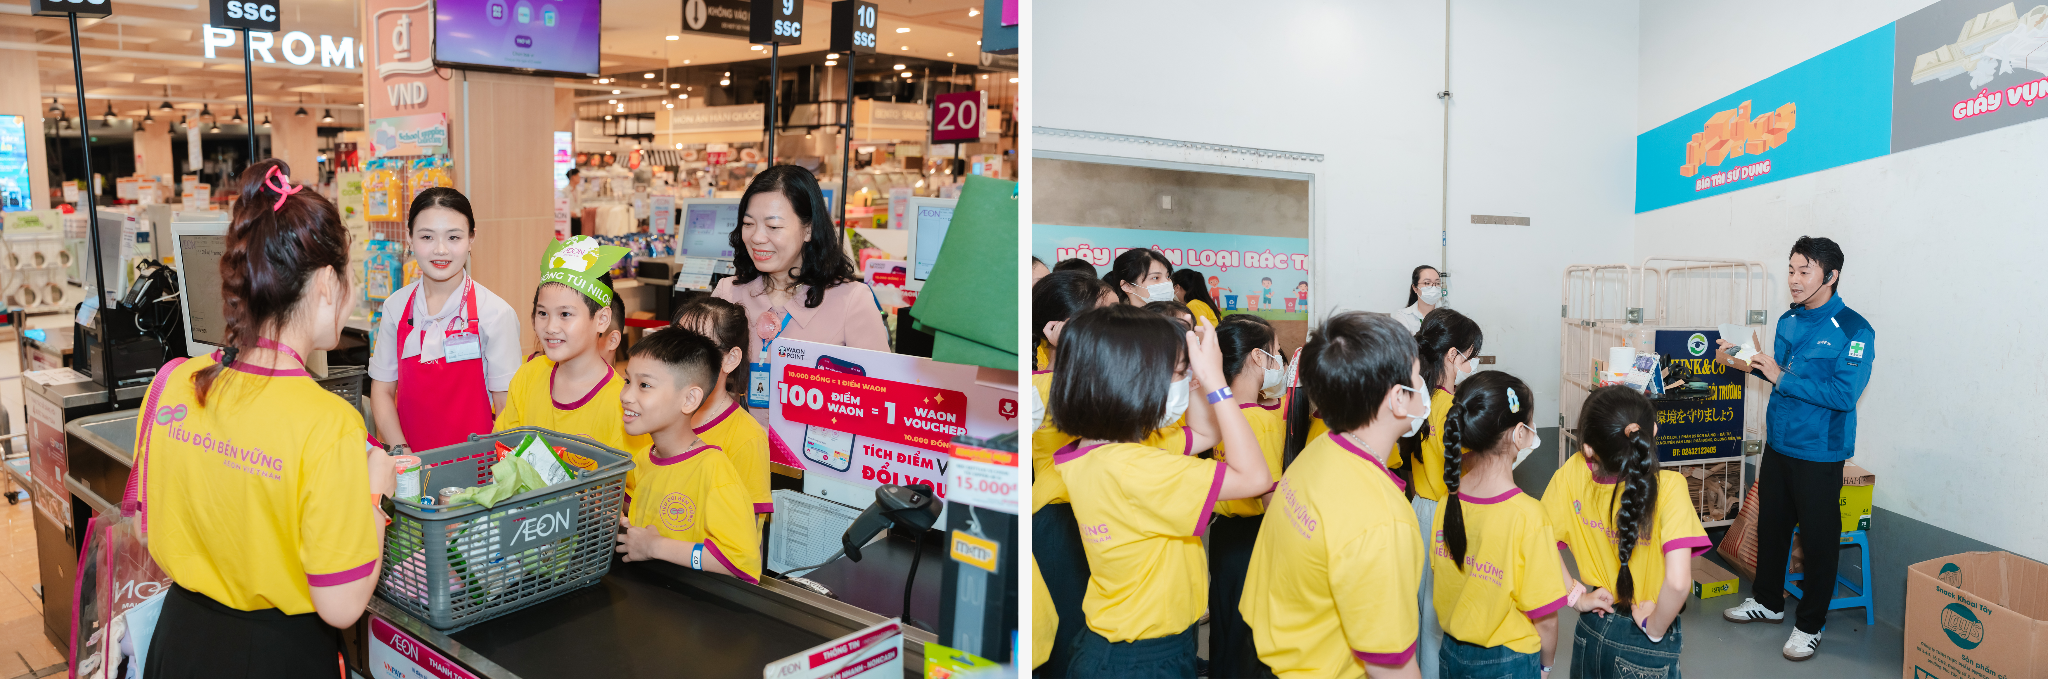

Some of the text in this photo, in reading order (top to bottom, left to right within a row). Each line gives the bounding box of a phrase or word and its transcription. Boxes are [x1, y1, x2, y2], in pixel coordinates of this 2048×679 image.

[227, 1, 276, 22] SSC
[857, 5, 876, 29] 10
[775, 20, 801, 38] SSC
[854, 31, 877, 48] SSC
[203, 24, 363, 69] PROM
[387, 81, 429, 107] VND
[1952, 87, 2003, 121] GIẤY
[937, 99, 977, 131] 20
[1741, 159, 1771, 181] DỤNG
[1187, 248, 1240, 272] LOẠI
[1244, 249, 1289, 270] RÁC
[567, 274, 587, 289] TÚI
[786, 347, 805, 355] WAON
[786, 353, 805, 361] POINT
[778, 382, 824, 410] 100
[831, 391, 861, 405] ĐIỂM
[862, 383, 887, 393] WAON
[827, 402, 864, 418] WAON
[884, 401, 896, 425] 1
[913, 406, 956, 423] WAON
[903, 417, 967, 436] VOUCHER
[192, 432, 216, 453] ĐỘI
[240, 447, 283, 471] VỮNG
[863, 442, 893, 461] TÍCH
[896, 451, 934, 470] ĐIỂM
[242, 465, 281, 481] VIETNAM
[1936, 585, 1993, 616] Snack Khoai Tây
[823, 639, 860, 661] THÔNG TIN
[429, 657, 453, 679] THANH
